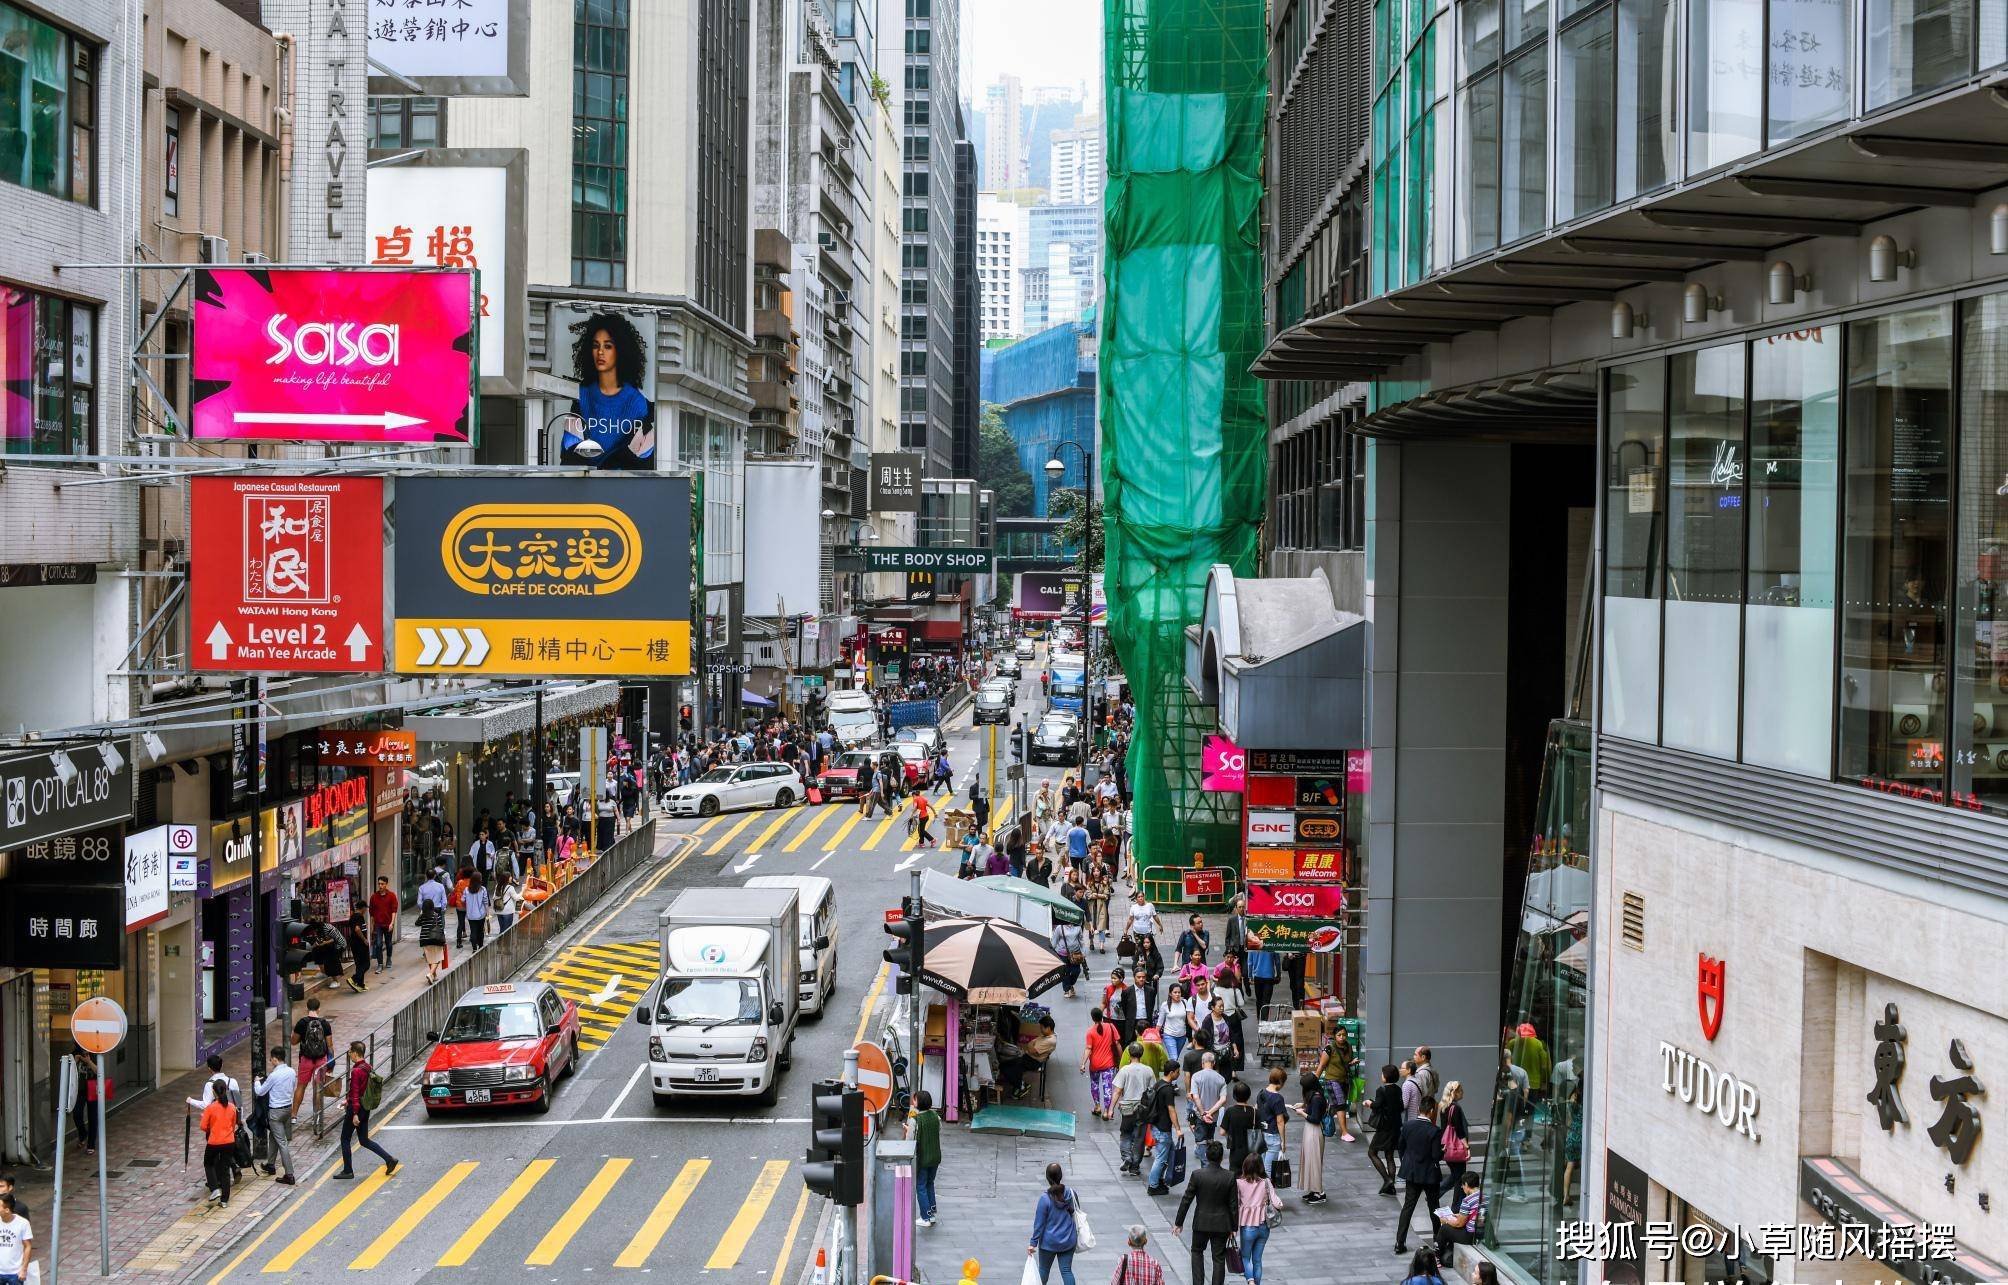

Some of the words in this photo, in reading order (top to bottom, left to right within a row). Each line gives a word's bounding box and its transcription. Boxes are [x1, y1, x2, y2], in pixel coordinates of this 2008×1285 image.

[326, 59, 347, 240] TRAVEL
[273, 371, 314, 391] making
[315, 371, 338, 391] life
[340, 372, 392, 391] beautiful
[563, 417, 643, 435] TOPSHOP
[880, 467, 912, 487] 周生生
[233, 482, 269, 492] Japanese
[270, 482, 297, 492] Casual
[298, 483, 341, 492] Restaurant
[260, 505, 309, 594] 和民
[872, 553, 899, 565] THE
[904, 553, 943, 565] BODY
[249, 557, 263, 594] わたみ
[492, 582, 526, 595] CAFÉ
[528, 584, 545, 595] DE
[548, 584, 593, 596] CORAL
[238, 606, 279, 615] WATAMI
[282, 607, 308, 617] Hong
[311, 607, 338, 617] Kong
[248, 623, 307, 645] Level
[312, 624, 326, 645] 2
[238, 646, 265, 658] Man
[268, 646, 290, 658] Yee
[293, 647, 337, 659] Arcade
[510, 637, 670, 662] 勵精中心一樓
[706, 664, 752, 674] TOPSHOP
[32, 770, 92, 815] OPTICAL
[93, 766, 110, 801] 88
[324, 776, 366, 818] BONJOUR
[1302, 792, 1321, 803] 8/F
[1252, 824, 1291, 833] GNC
[1302, 854, 1335, 869] 惠康
[1299, 869, 1337, 877] wellcome
[29, 917, 99, 939] 時間廊
[1660, 1039, 1762, 1143] TUDOR
